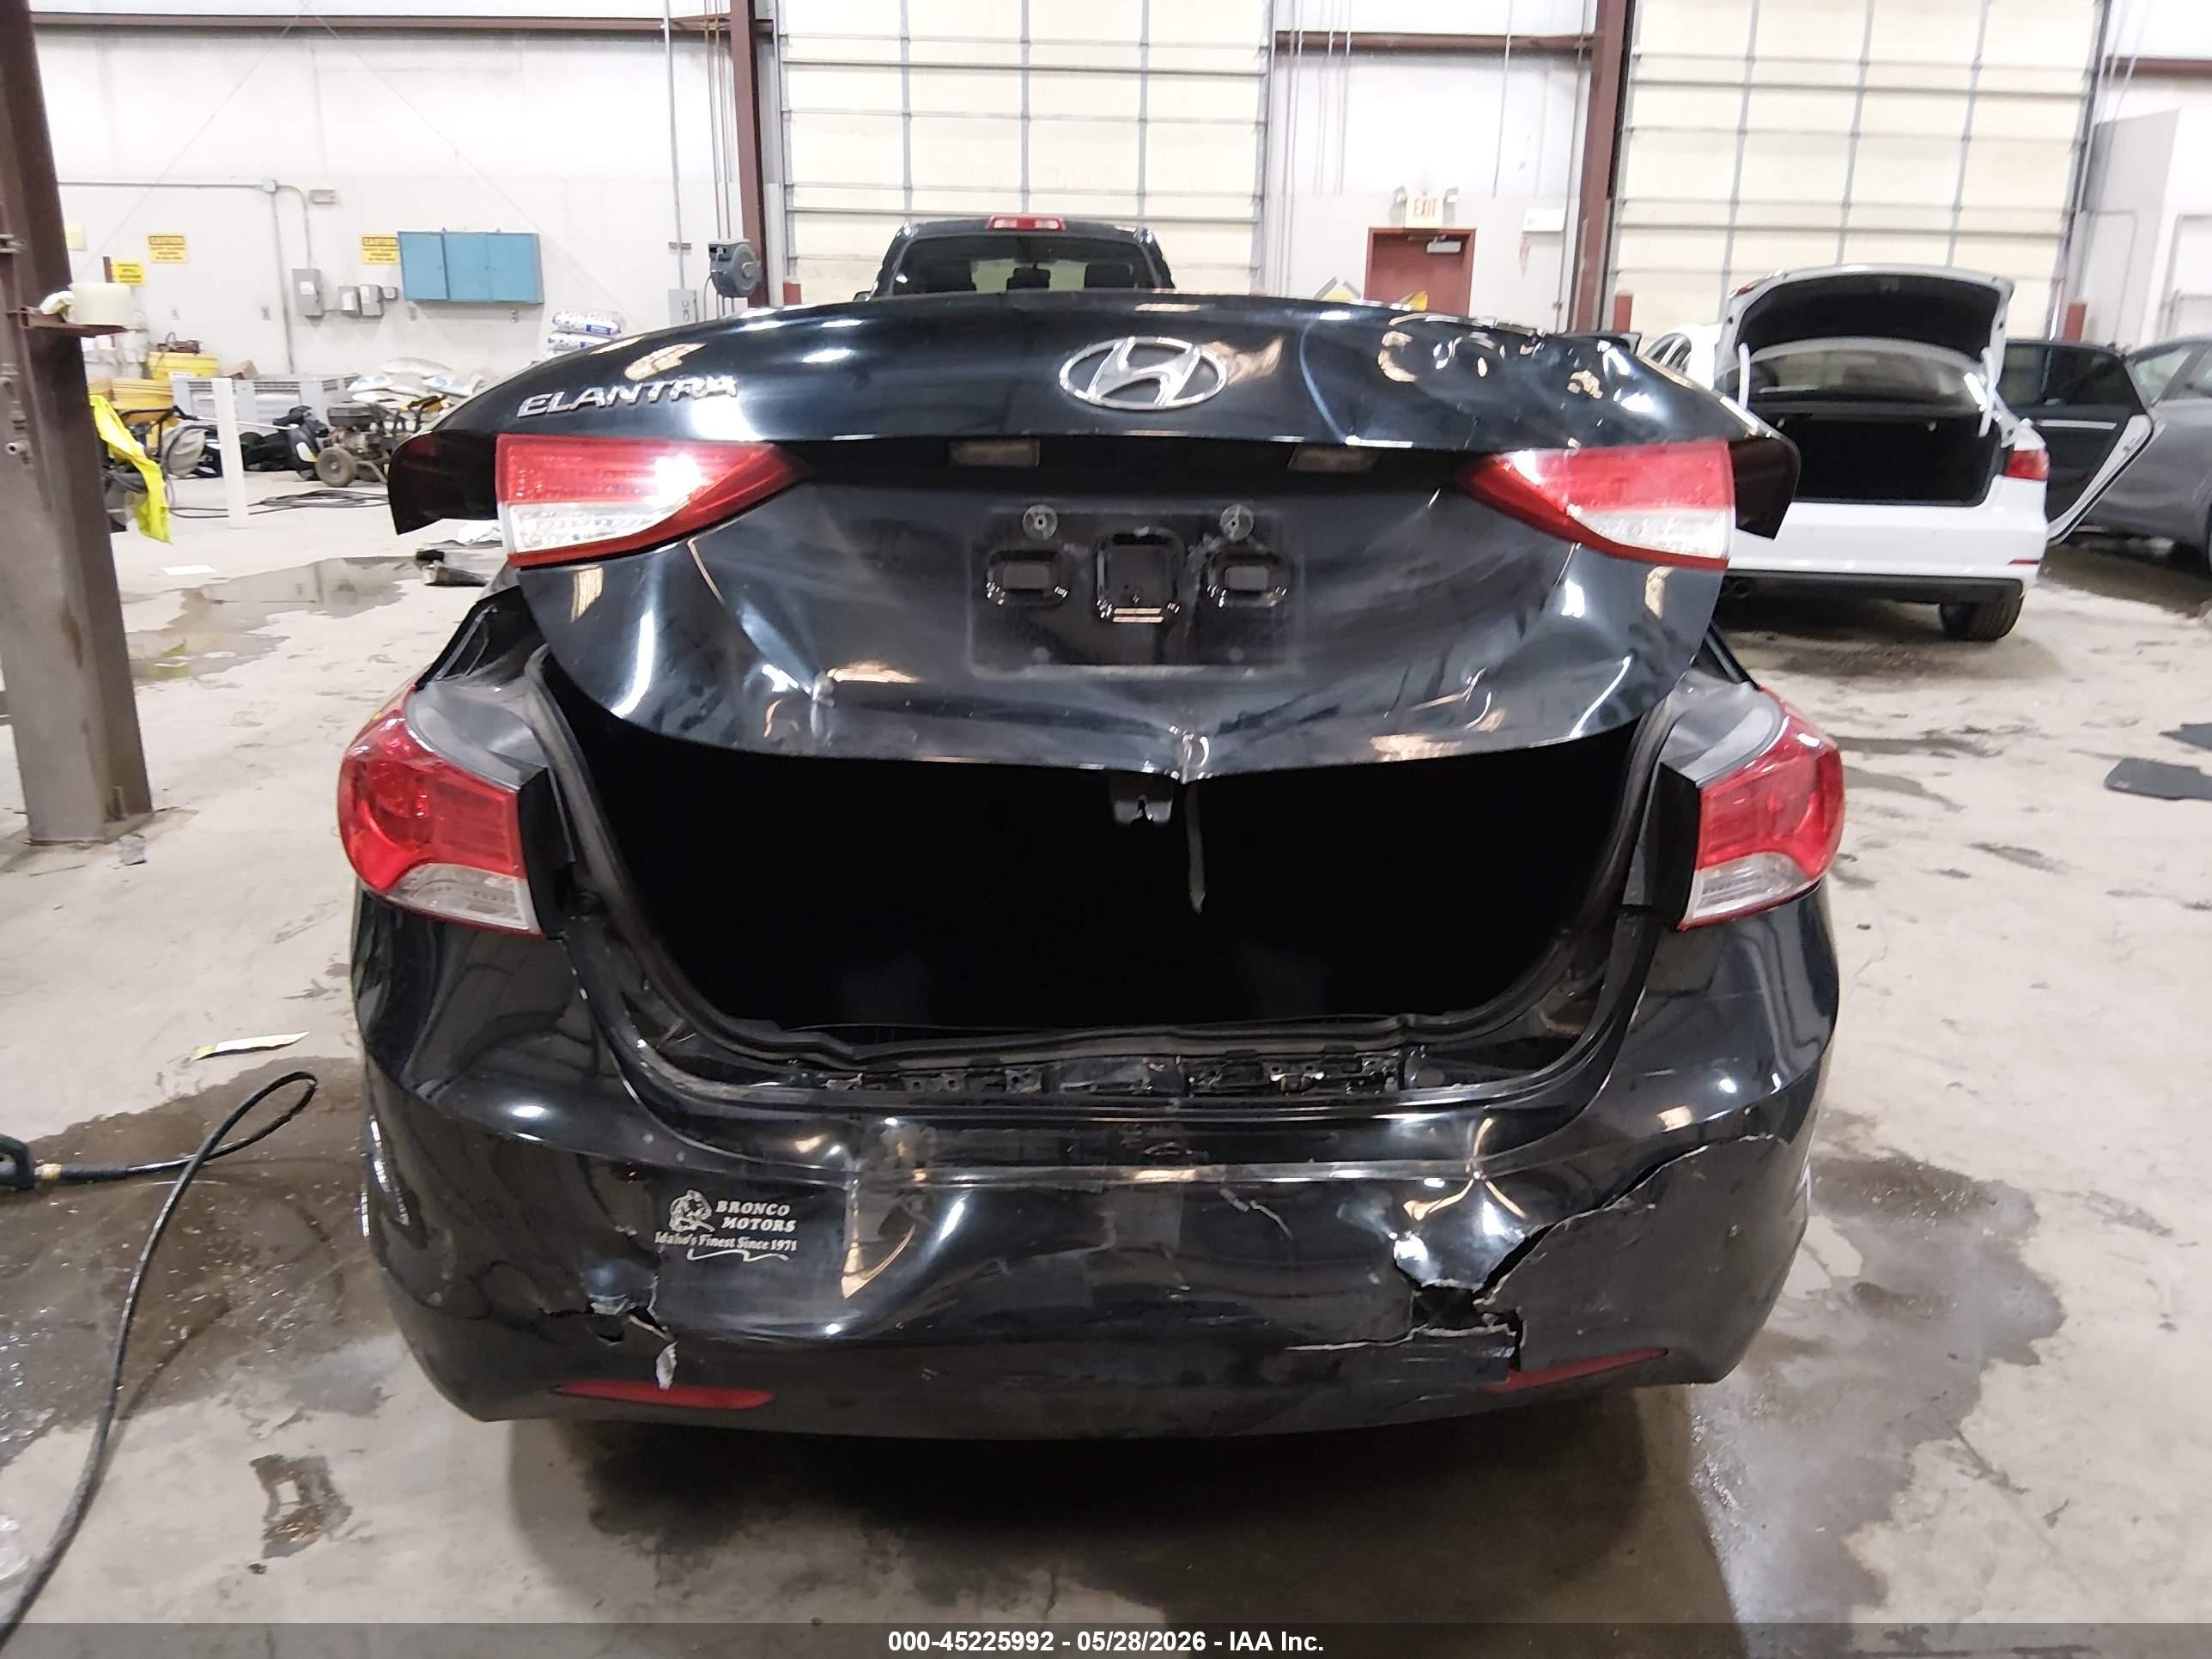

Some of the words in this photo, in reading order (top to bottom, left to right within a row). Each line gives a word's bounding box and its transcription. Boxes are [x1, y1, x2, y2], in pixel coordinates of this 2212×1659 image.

[1413, 198, 1437, 218] EXIT
[516, 375, 738, 418] ELANTRA
[715, 1200, 790, 1217] BRONCO
[720, 1217, 797, 1233] MOTORS
[698, 1233, 737, 1249] Finest
[737, 1236, 770, 1250] Since
[771, 1239, 798, 1252] 1971
